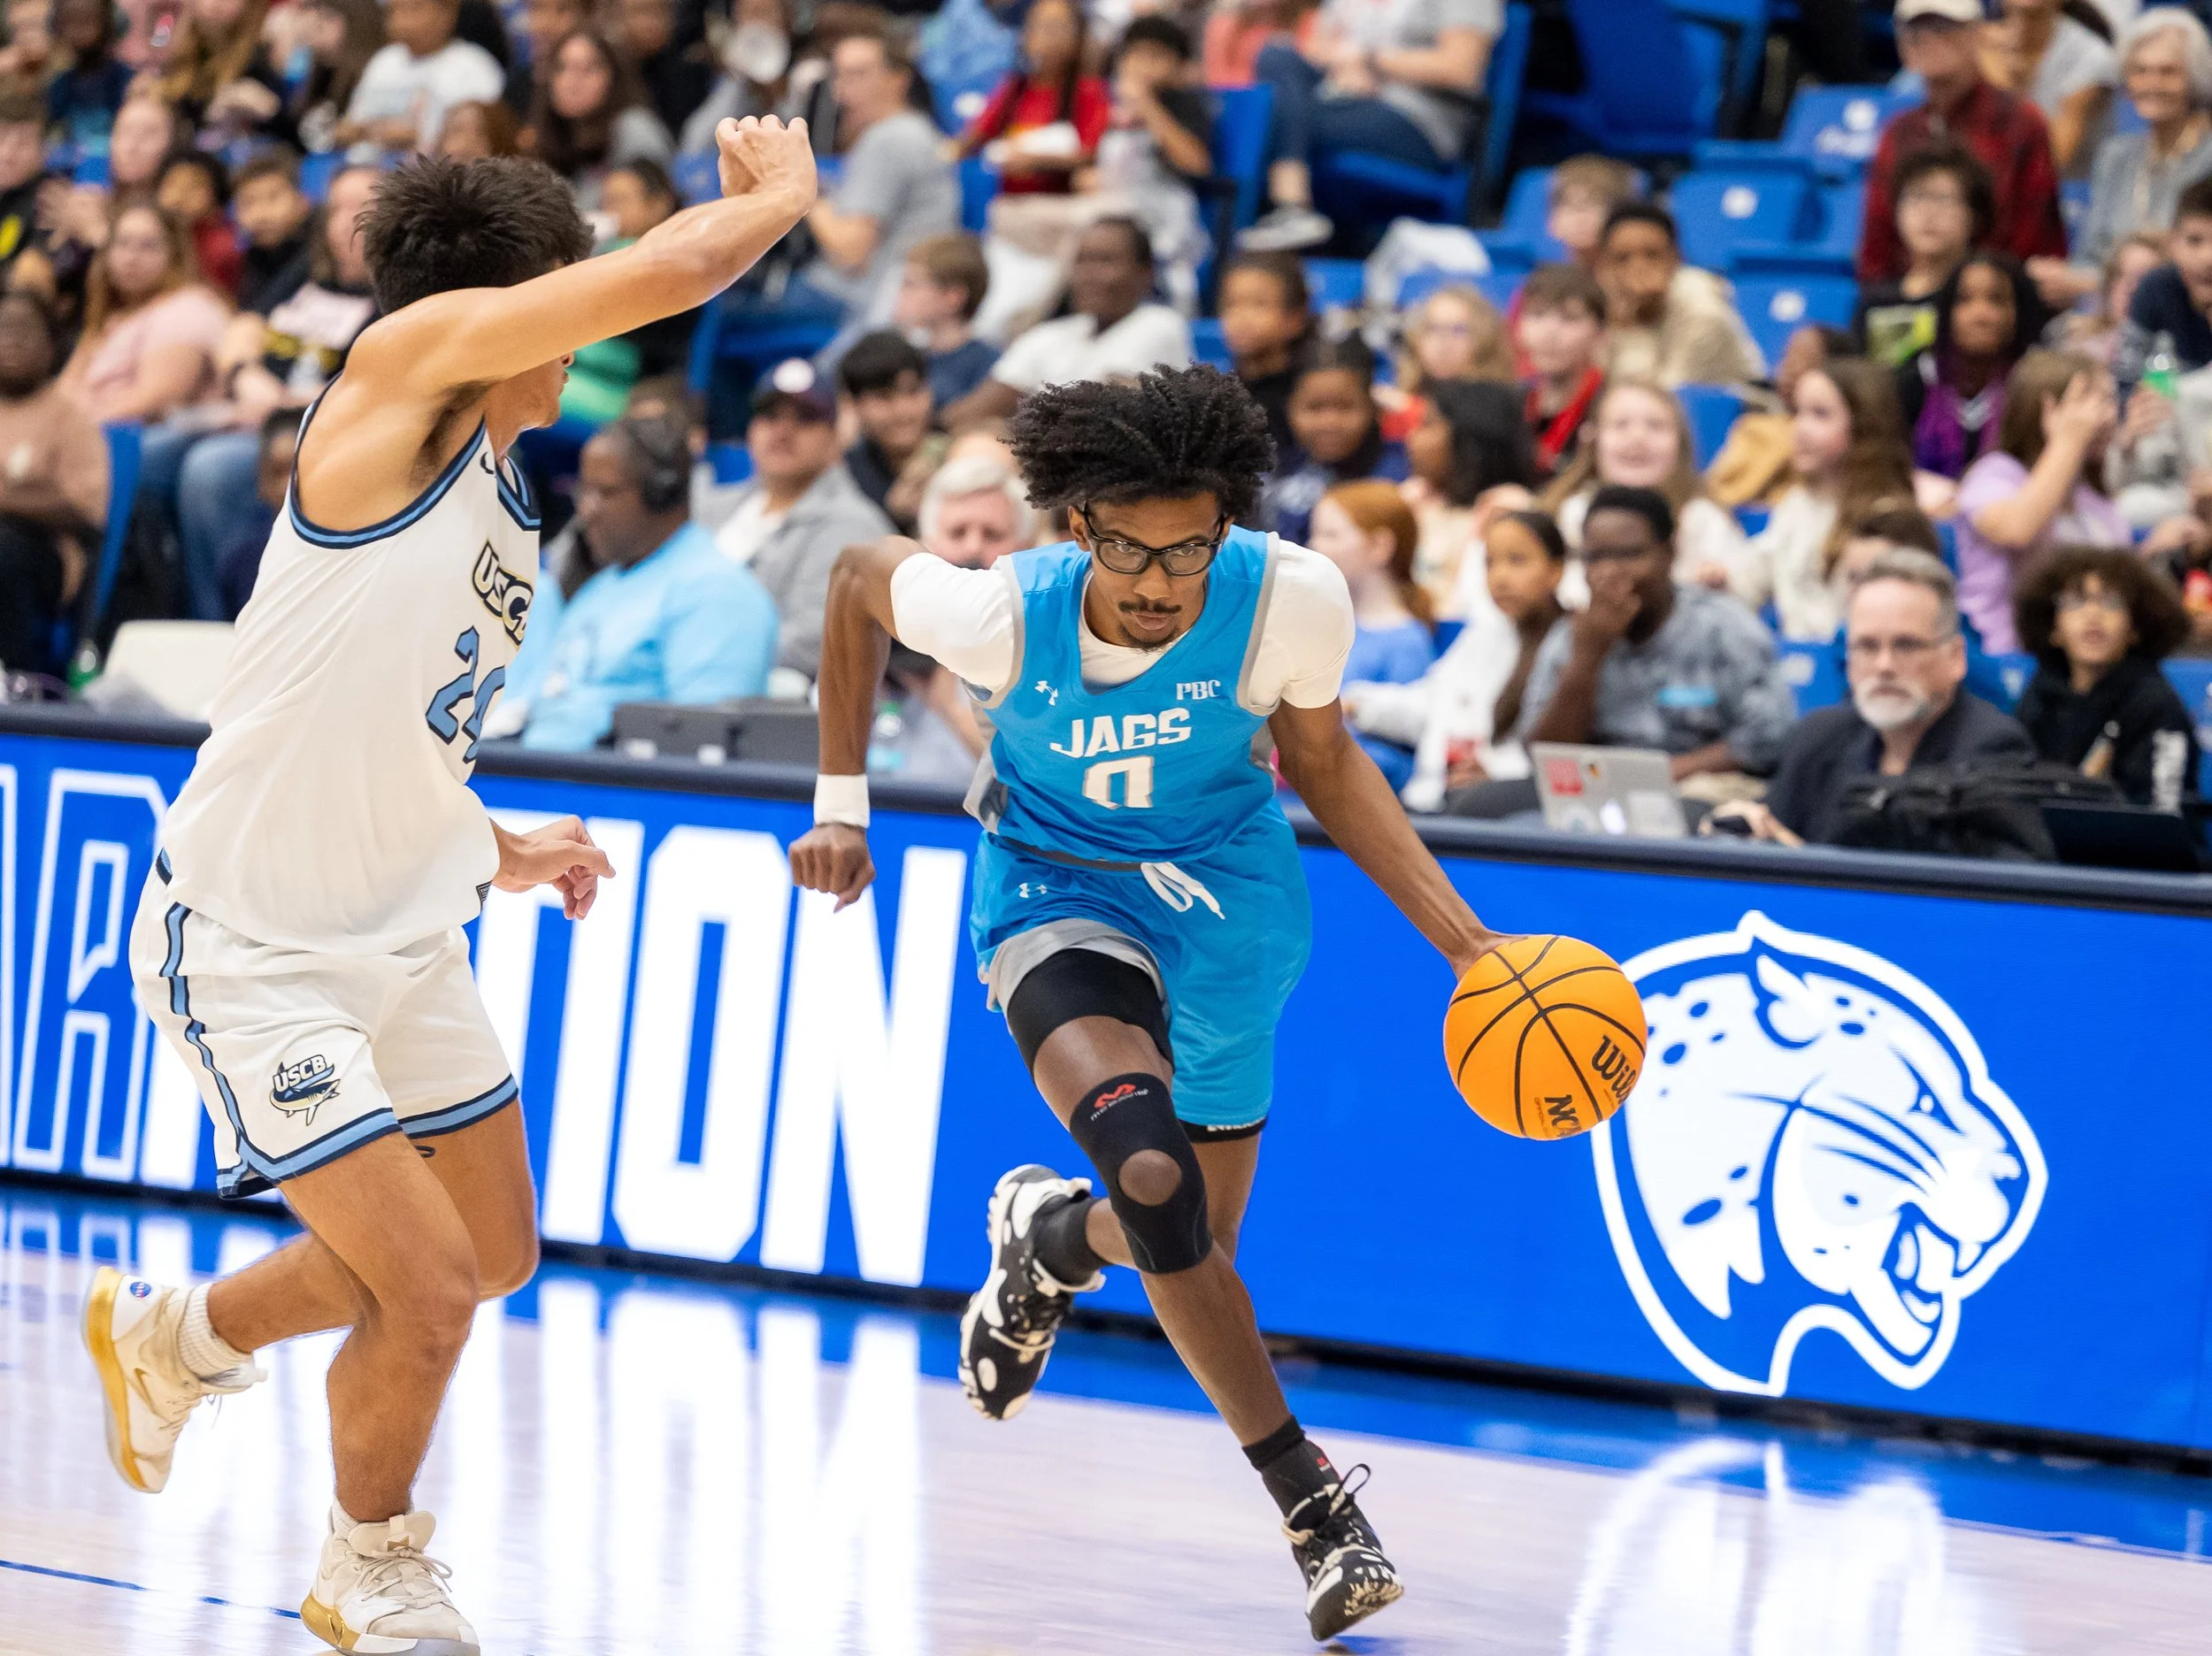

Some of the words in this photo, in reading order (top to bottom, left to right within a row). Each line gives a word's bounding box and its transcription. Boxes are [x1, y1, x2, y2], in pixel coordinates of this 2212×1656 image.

[1176, 679, 1221, 701] PBC
[1049, 707, 1192, 759] JAGS
[1081, 754, 1155, 811] 0
[273, 1054, 327, 1093] USCB
